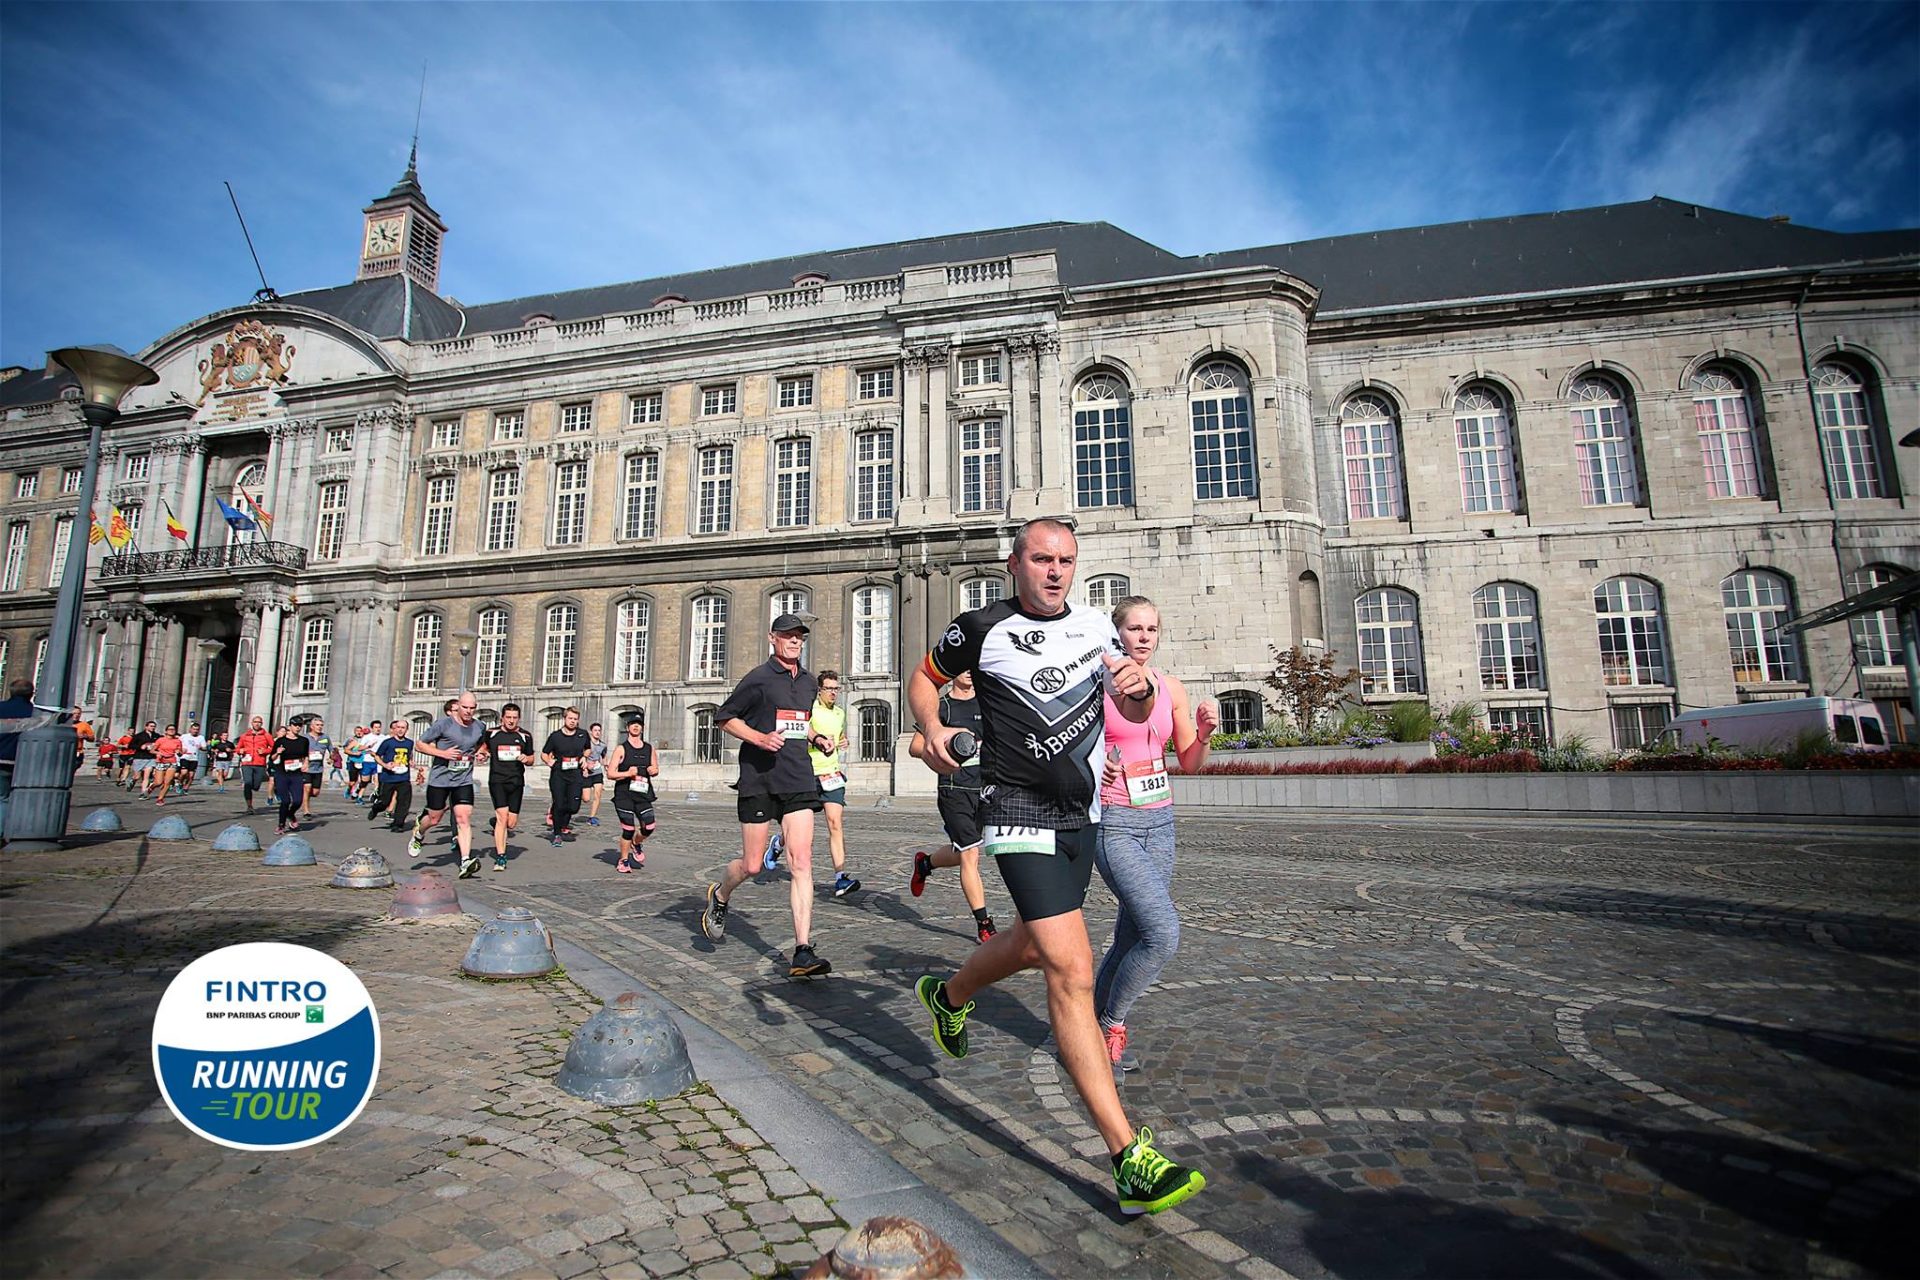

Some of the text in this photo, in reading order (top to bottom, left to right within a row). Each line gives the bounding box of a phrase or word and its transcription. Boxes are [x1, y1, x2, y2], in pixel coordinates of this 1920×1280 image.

[1065, 661, 1079, 674] FN
[785, 722, 805, 731] 1125
[1140, 776, 1166, 792] 1813
